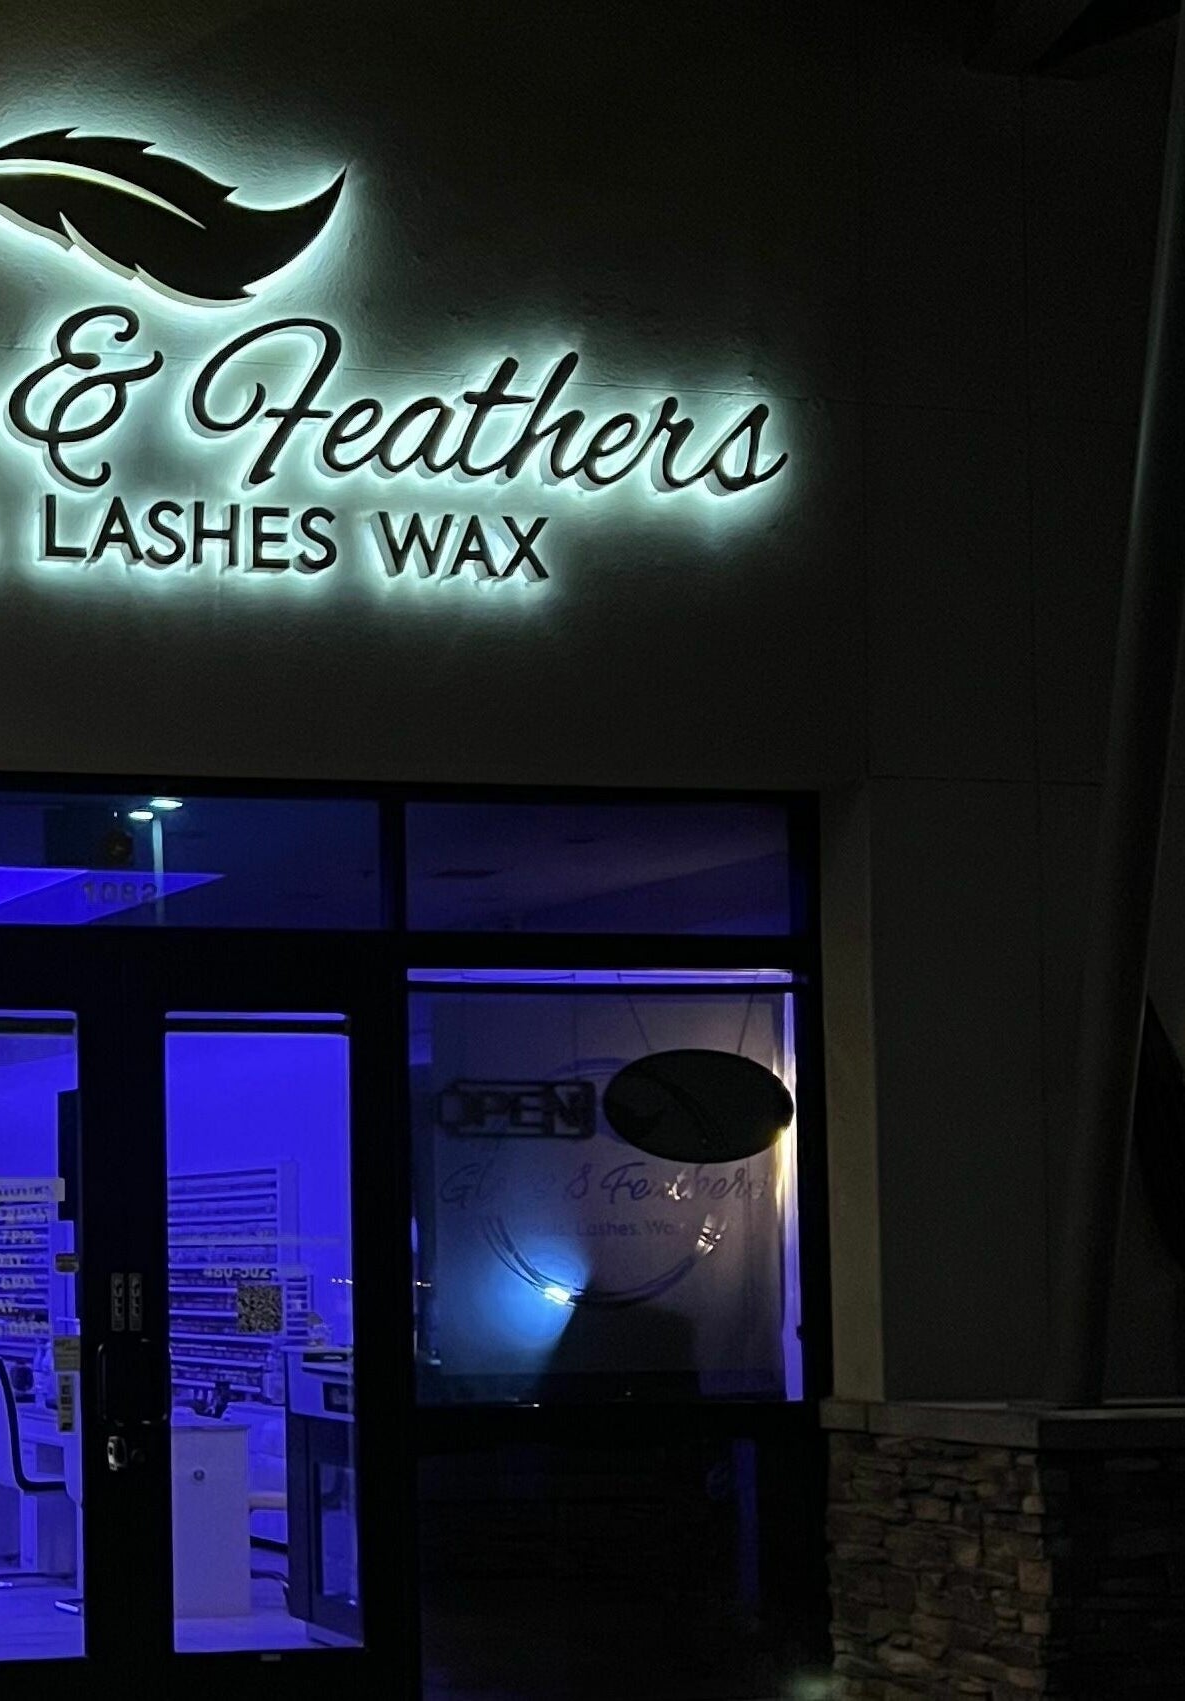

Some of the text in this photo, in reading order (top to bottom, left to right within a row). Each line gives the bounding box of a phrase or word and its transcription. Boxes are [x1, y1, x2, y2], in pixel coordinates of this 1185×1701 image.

[7, 305, 163, 486] &
[189, 317, 789, 490] Feathers
[43, 493, 338, 572] LASHES
[373, 510, 550, 582] WAX
